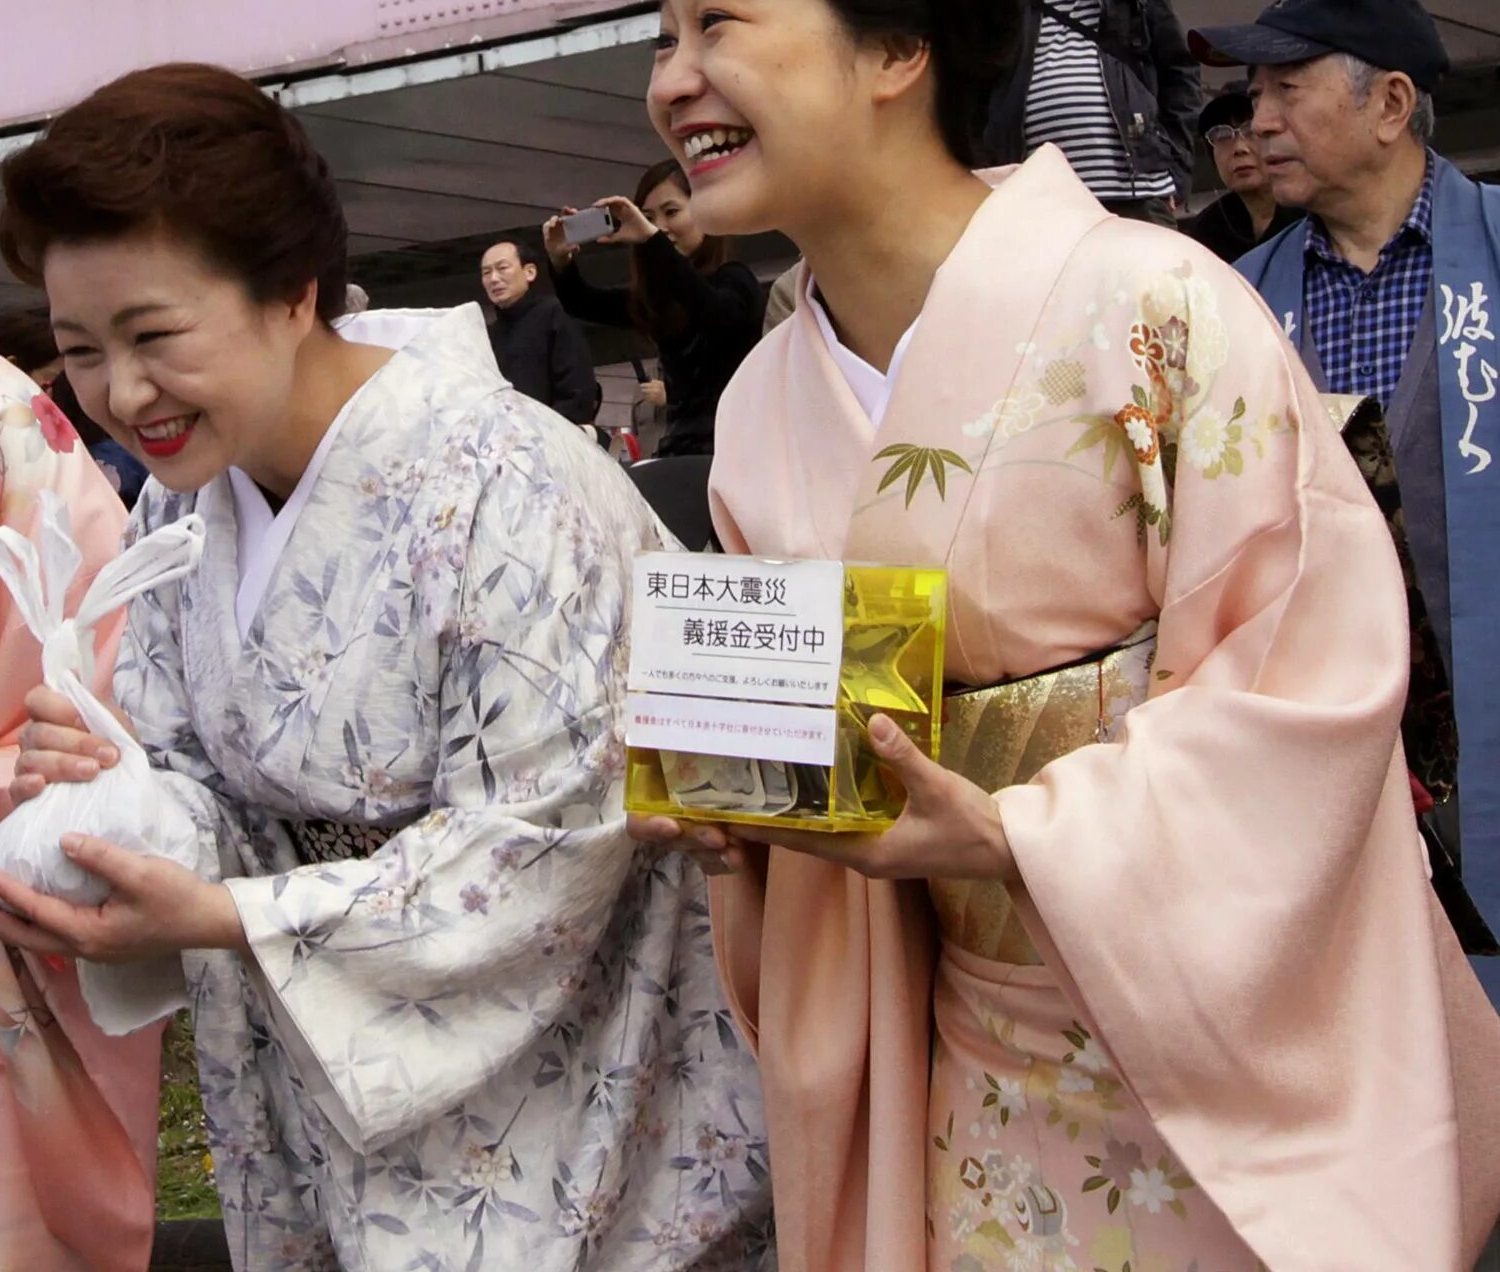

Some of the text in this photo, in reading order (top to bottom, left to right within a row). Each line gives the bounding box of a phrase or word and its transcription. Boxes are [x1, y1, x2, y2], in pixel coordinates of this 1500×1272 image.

[647, 572, 787, 606] 東日本大震災
[683, 618, 825, 653] 義援金受付中
